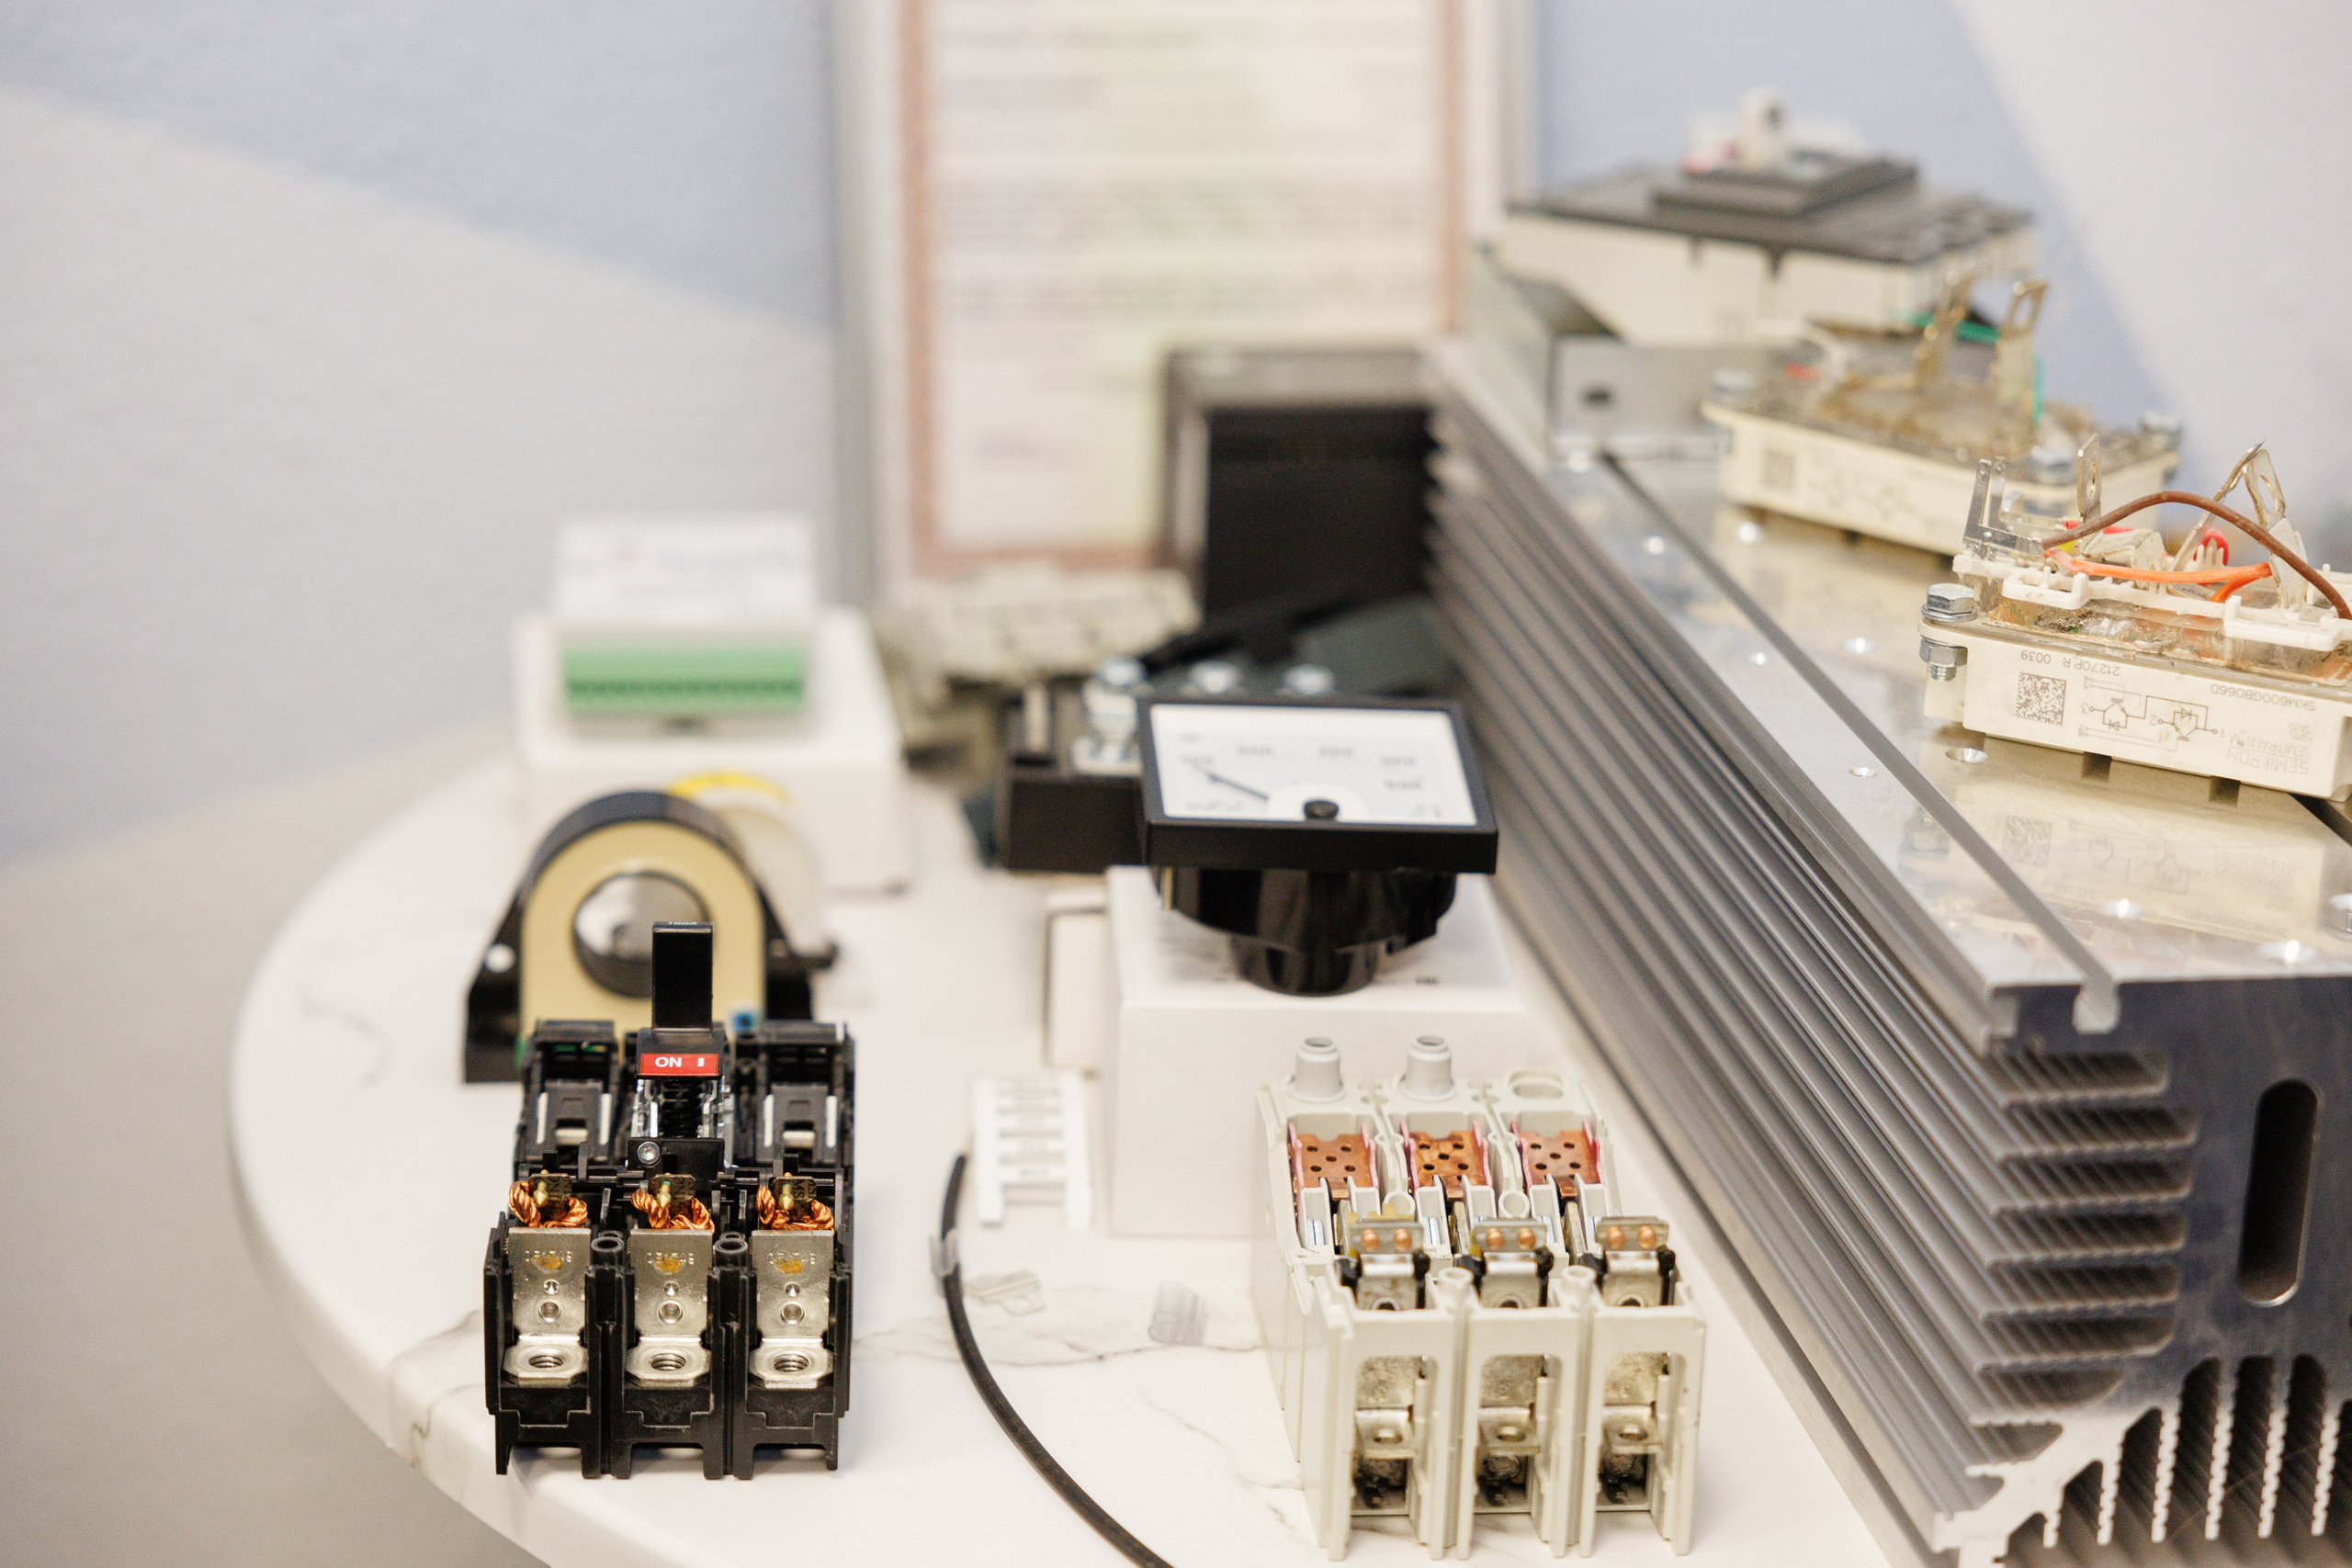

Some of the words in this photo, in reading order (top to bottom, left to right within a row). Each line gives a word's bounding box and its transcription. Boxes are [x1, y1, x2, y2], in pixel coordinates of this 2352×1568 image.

[2020, 649, 2052, 665] 0039
[2063, 657, 2071, 669] R
[2074, 660, 2121, 677] 21270P
[2210, 682, 2317, 712] SKM600GB066D
[2149, 714, 2158, 727] 2
[2227, 748, 2310, 774] SEMIKRON
[654, 1056, 683, 1067] ON
